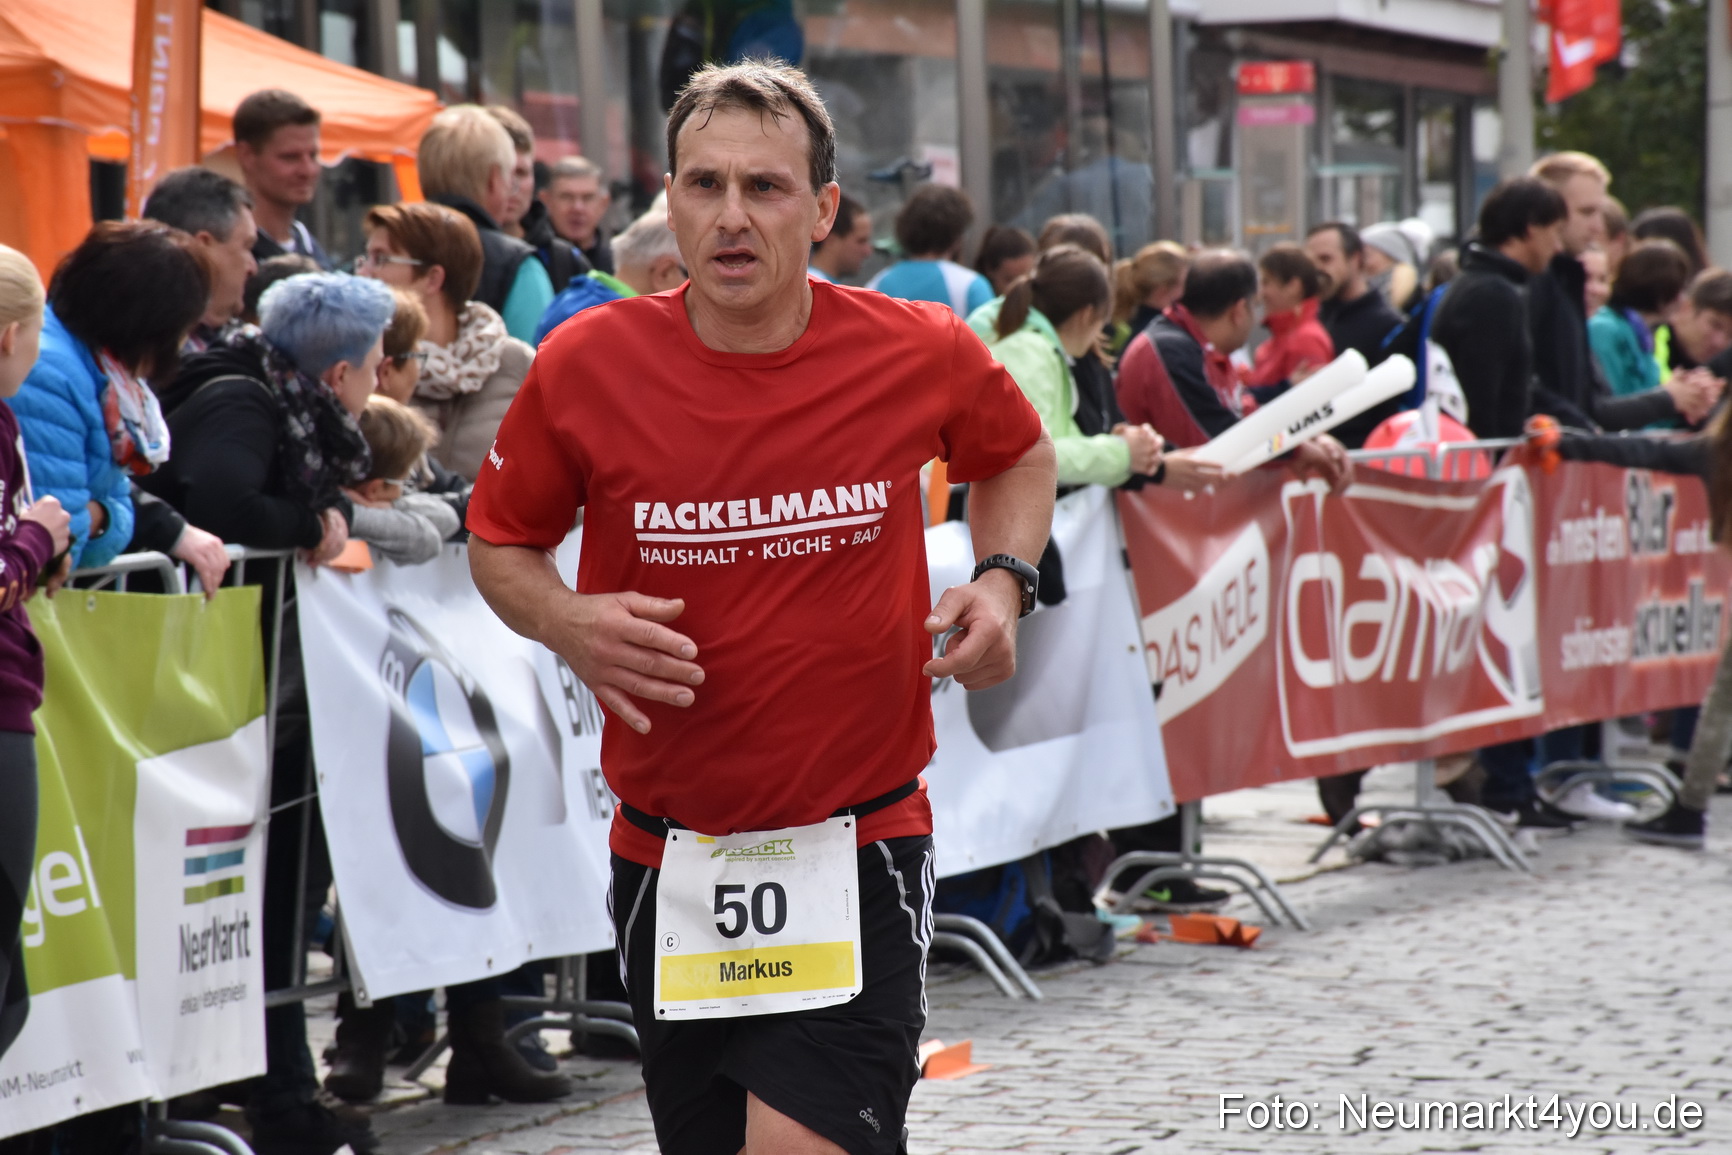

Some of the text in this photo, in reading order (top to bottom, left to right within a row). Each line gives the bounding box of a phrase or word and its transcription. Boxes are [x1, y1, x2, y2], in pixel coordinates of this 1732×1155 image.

[640, 525, 882, 565] HAUSHALT KÜCHE BAD
[713, 881, 788, 939] 50
[719, 958, 793, 982] Markus
